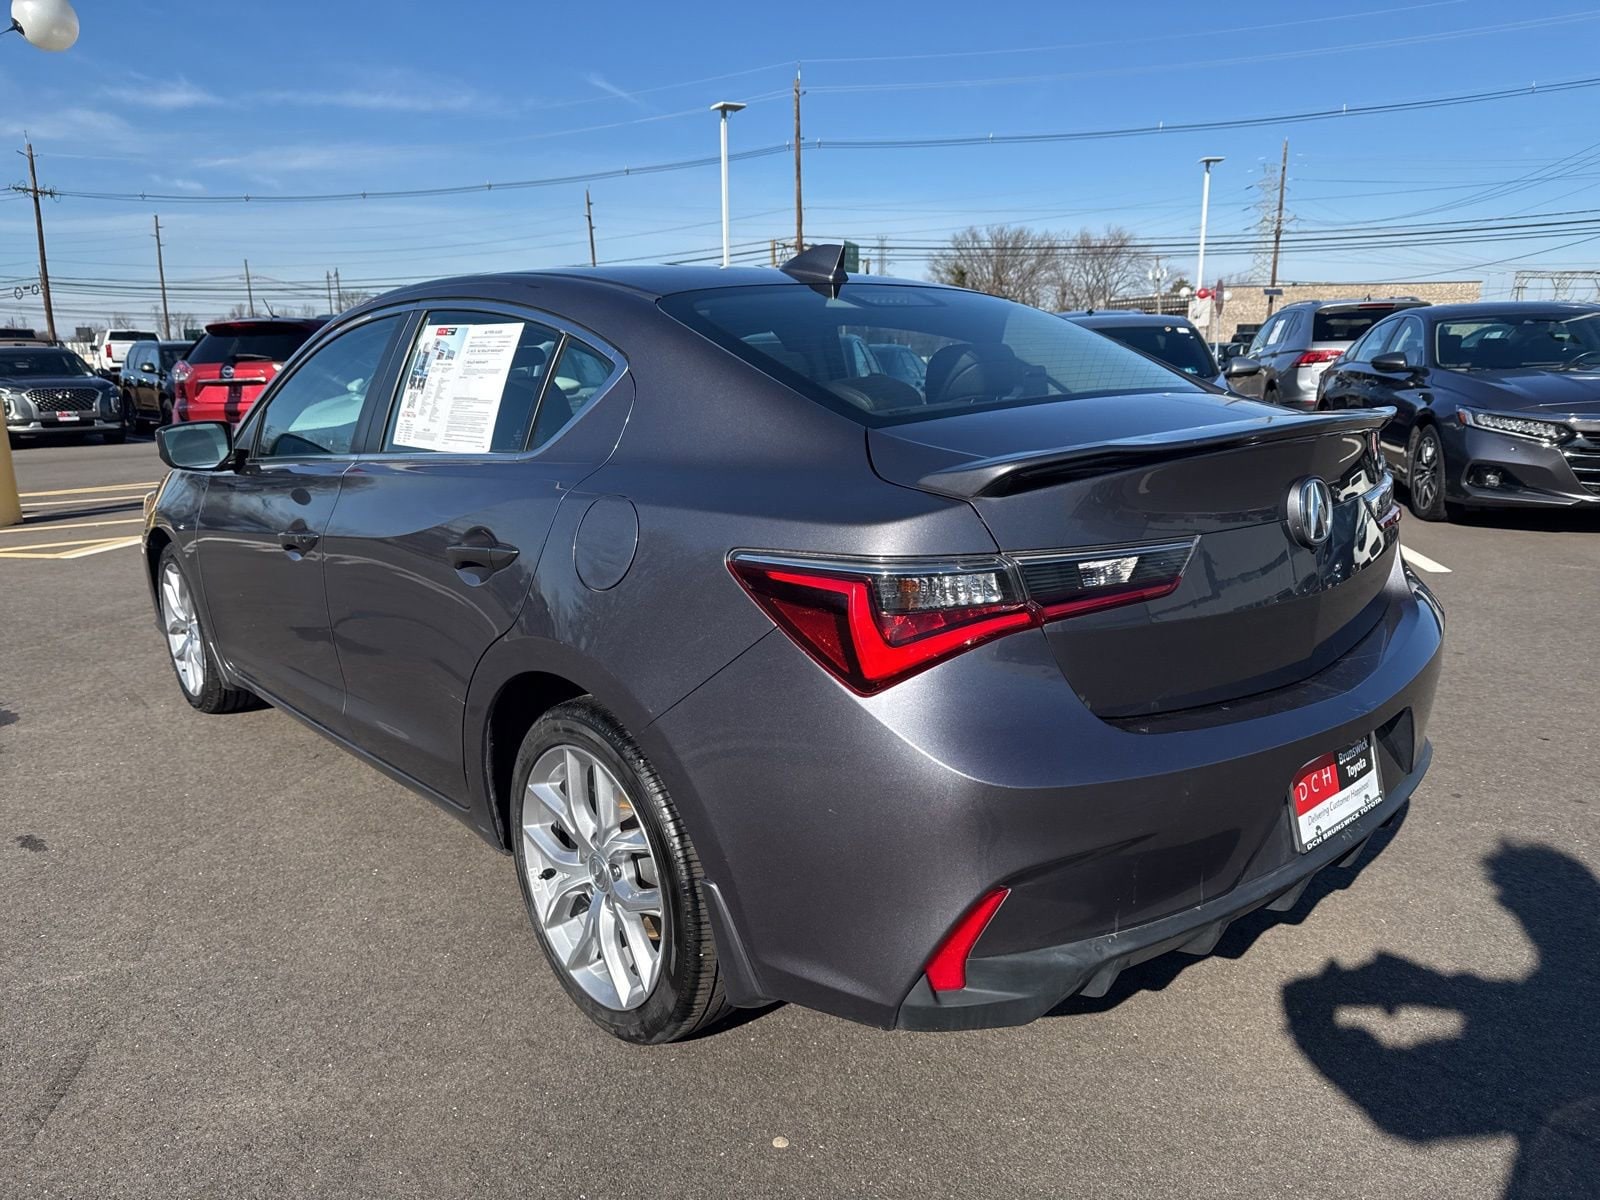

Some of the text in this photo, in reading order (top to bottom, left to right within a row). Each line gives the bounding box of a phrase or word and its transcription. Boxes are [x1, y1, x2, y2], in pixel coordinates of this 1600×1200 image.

[1338, 737, 1368, 765] Brunswick
[1346, 757, 1366, 778] Toyota
[1307, 797, 1383, 850] DCH BRUNSWICK TOYOTA
